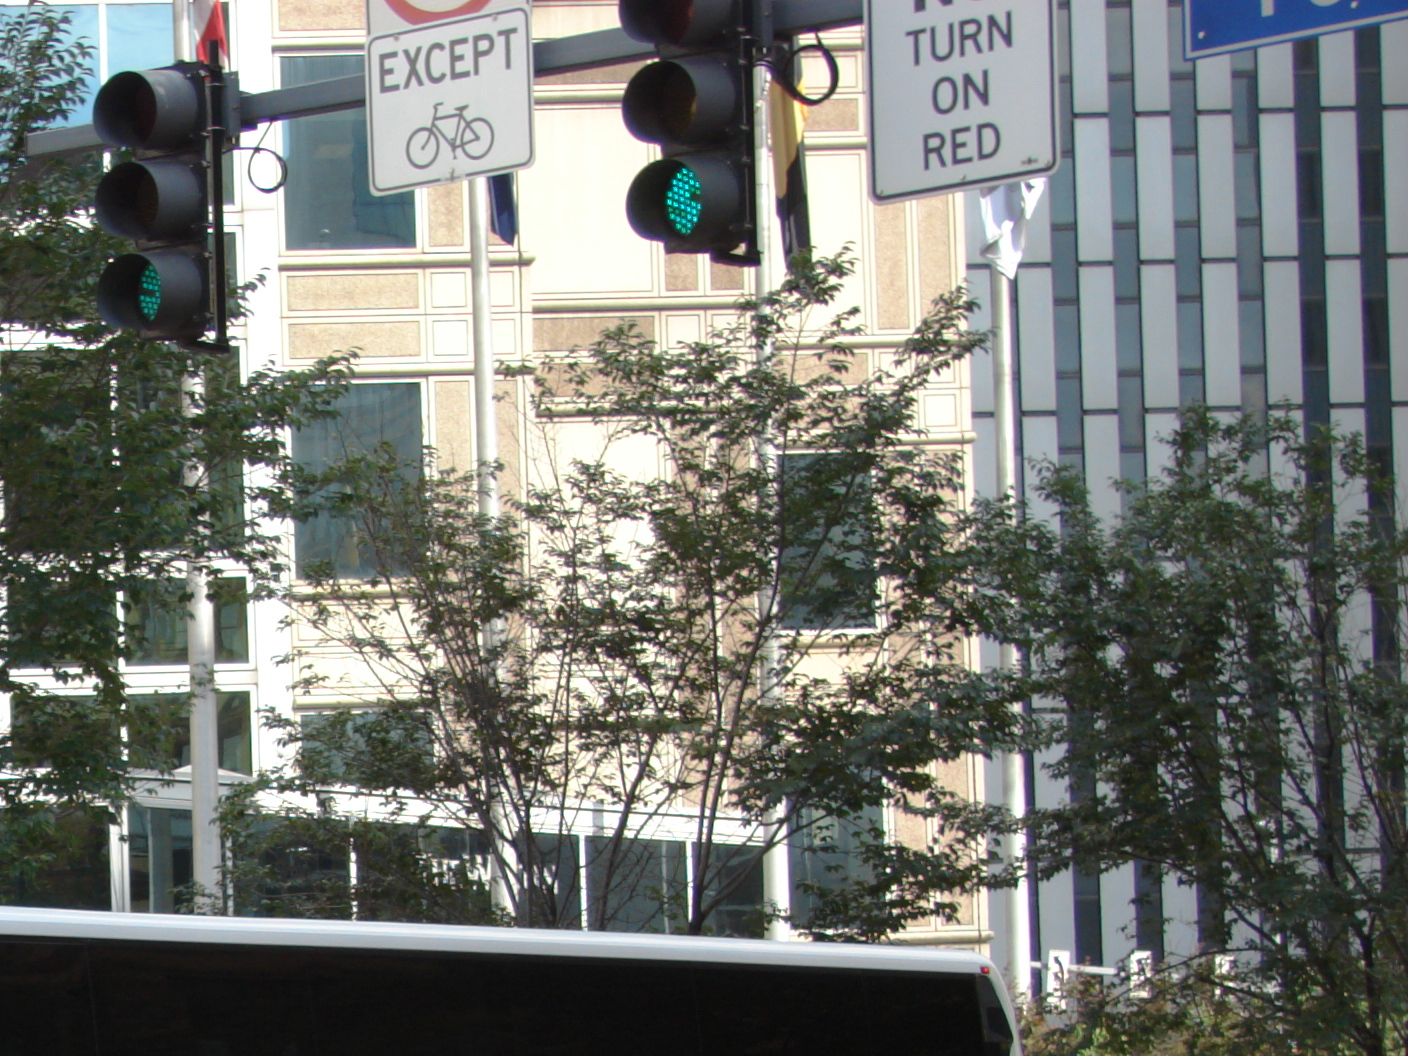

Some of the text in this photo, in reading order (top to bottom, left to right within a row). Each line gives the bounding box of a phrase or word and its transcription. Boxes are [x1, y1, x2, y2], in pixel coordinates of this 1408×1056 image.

[378, 27, 518, 94] EXCEPT
[905, 10, 1013, 66] TURN
[932, 69, 990, 115] ON
[923, 122, 1001, 171] RED
